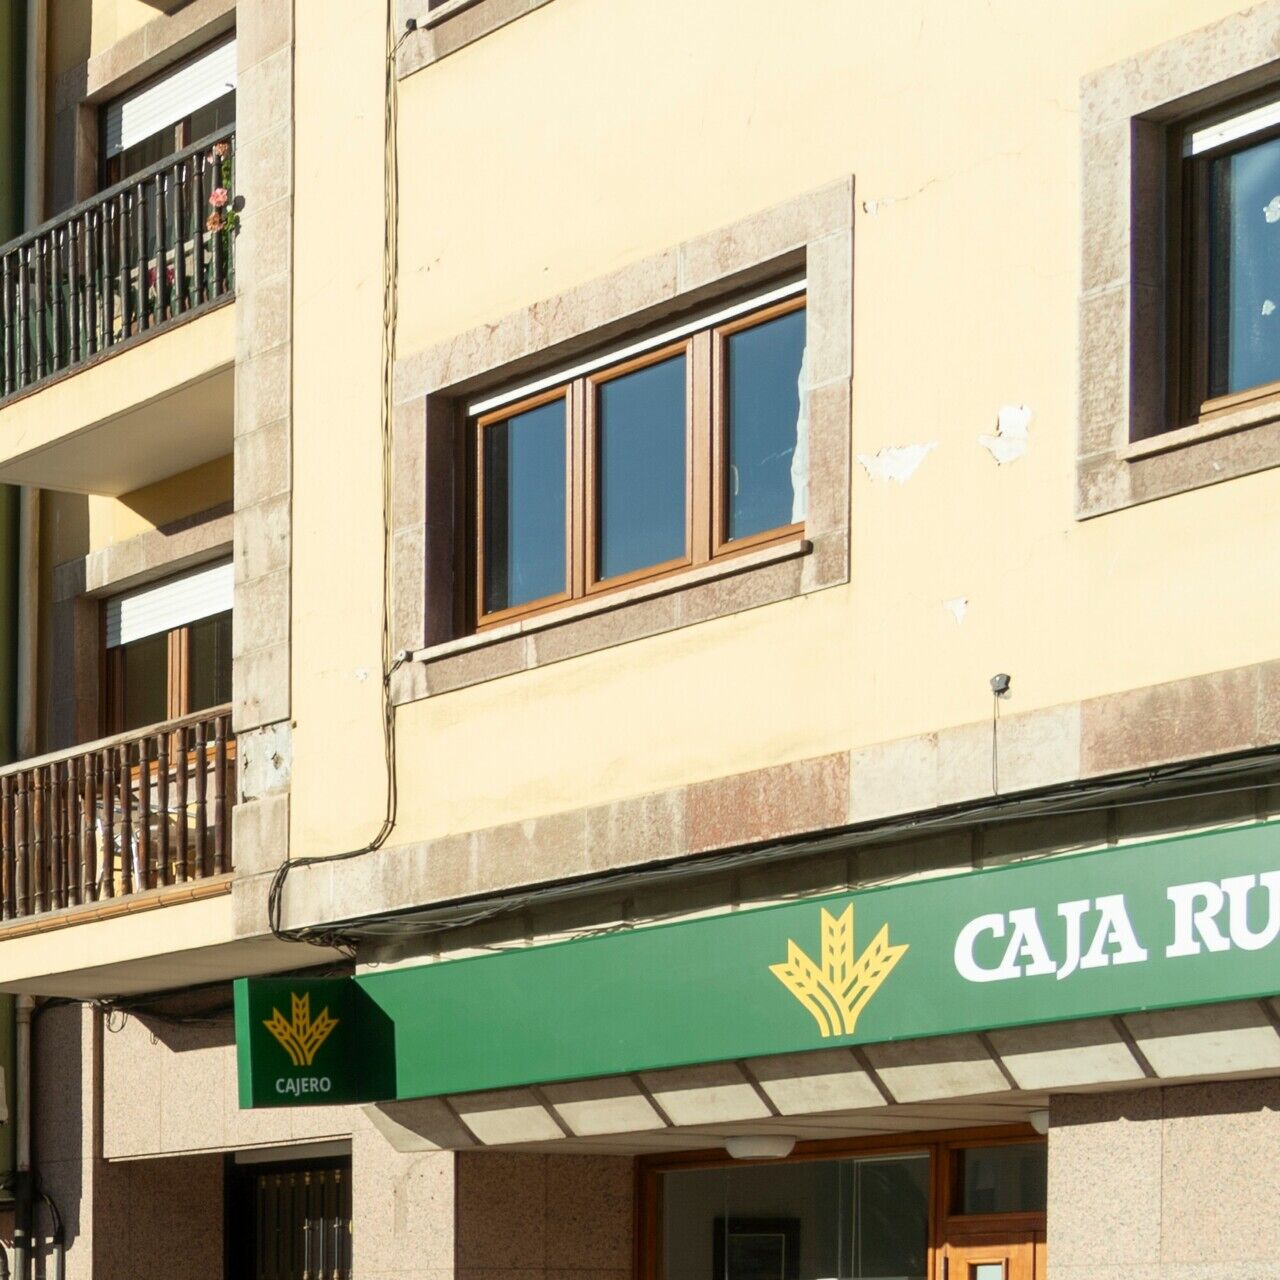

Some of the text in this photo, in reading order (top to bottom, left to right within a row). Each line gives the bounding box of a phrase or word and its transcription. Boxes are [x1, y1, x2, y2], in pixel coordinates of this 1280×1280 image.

[953, 870, 1280, 983] CAJA RU
[275, 1076, 331, 1097] CAJERO
